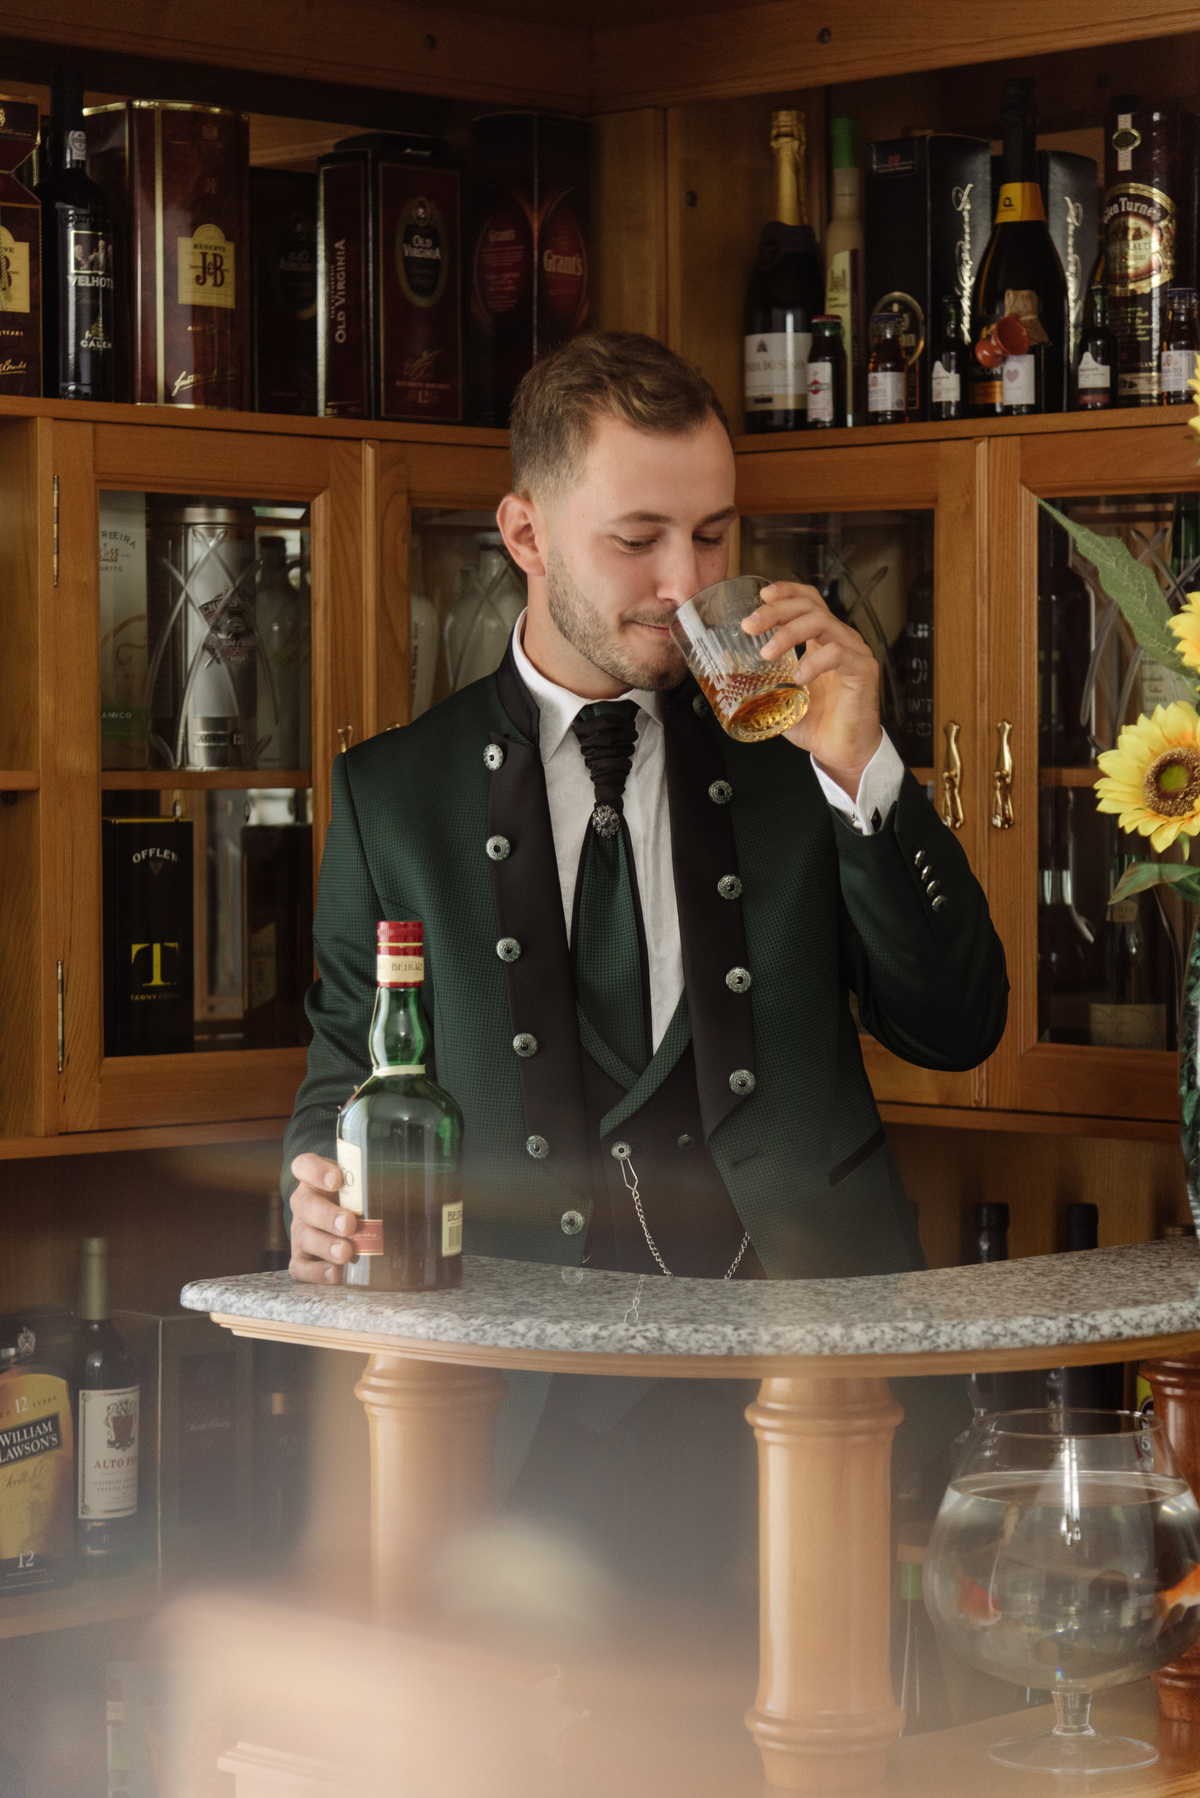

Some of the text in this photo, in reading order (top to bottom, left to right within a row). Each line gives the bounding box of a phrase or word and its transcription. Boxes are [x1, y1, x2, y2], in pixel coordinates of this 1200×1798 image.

[195, 252, 225, 288] J&B
[334, 238, 346, 344] OLD VIRGINIA
[132, 847, 179, 864] OFFLEY
[131, 942, 179, 987] T
[129, 993, 157, 1002] TAWNY
[15, 1396, 29, 1414] 12
[32, 1395, 57, 1408] YEARS
[0, 1420, 53, 1447] WILLIAM
[0, 1433, 58, 1463] LAWSON'S
[94, 1458, 124, 1469] ALTO
[17, 1550, 35, 1568] 12
